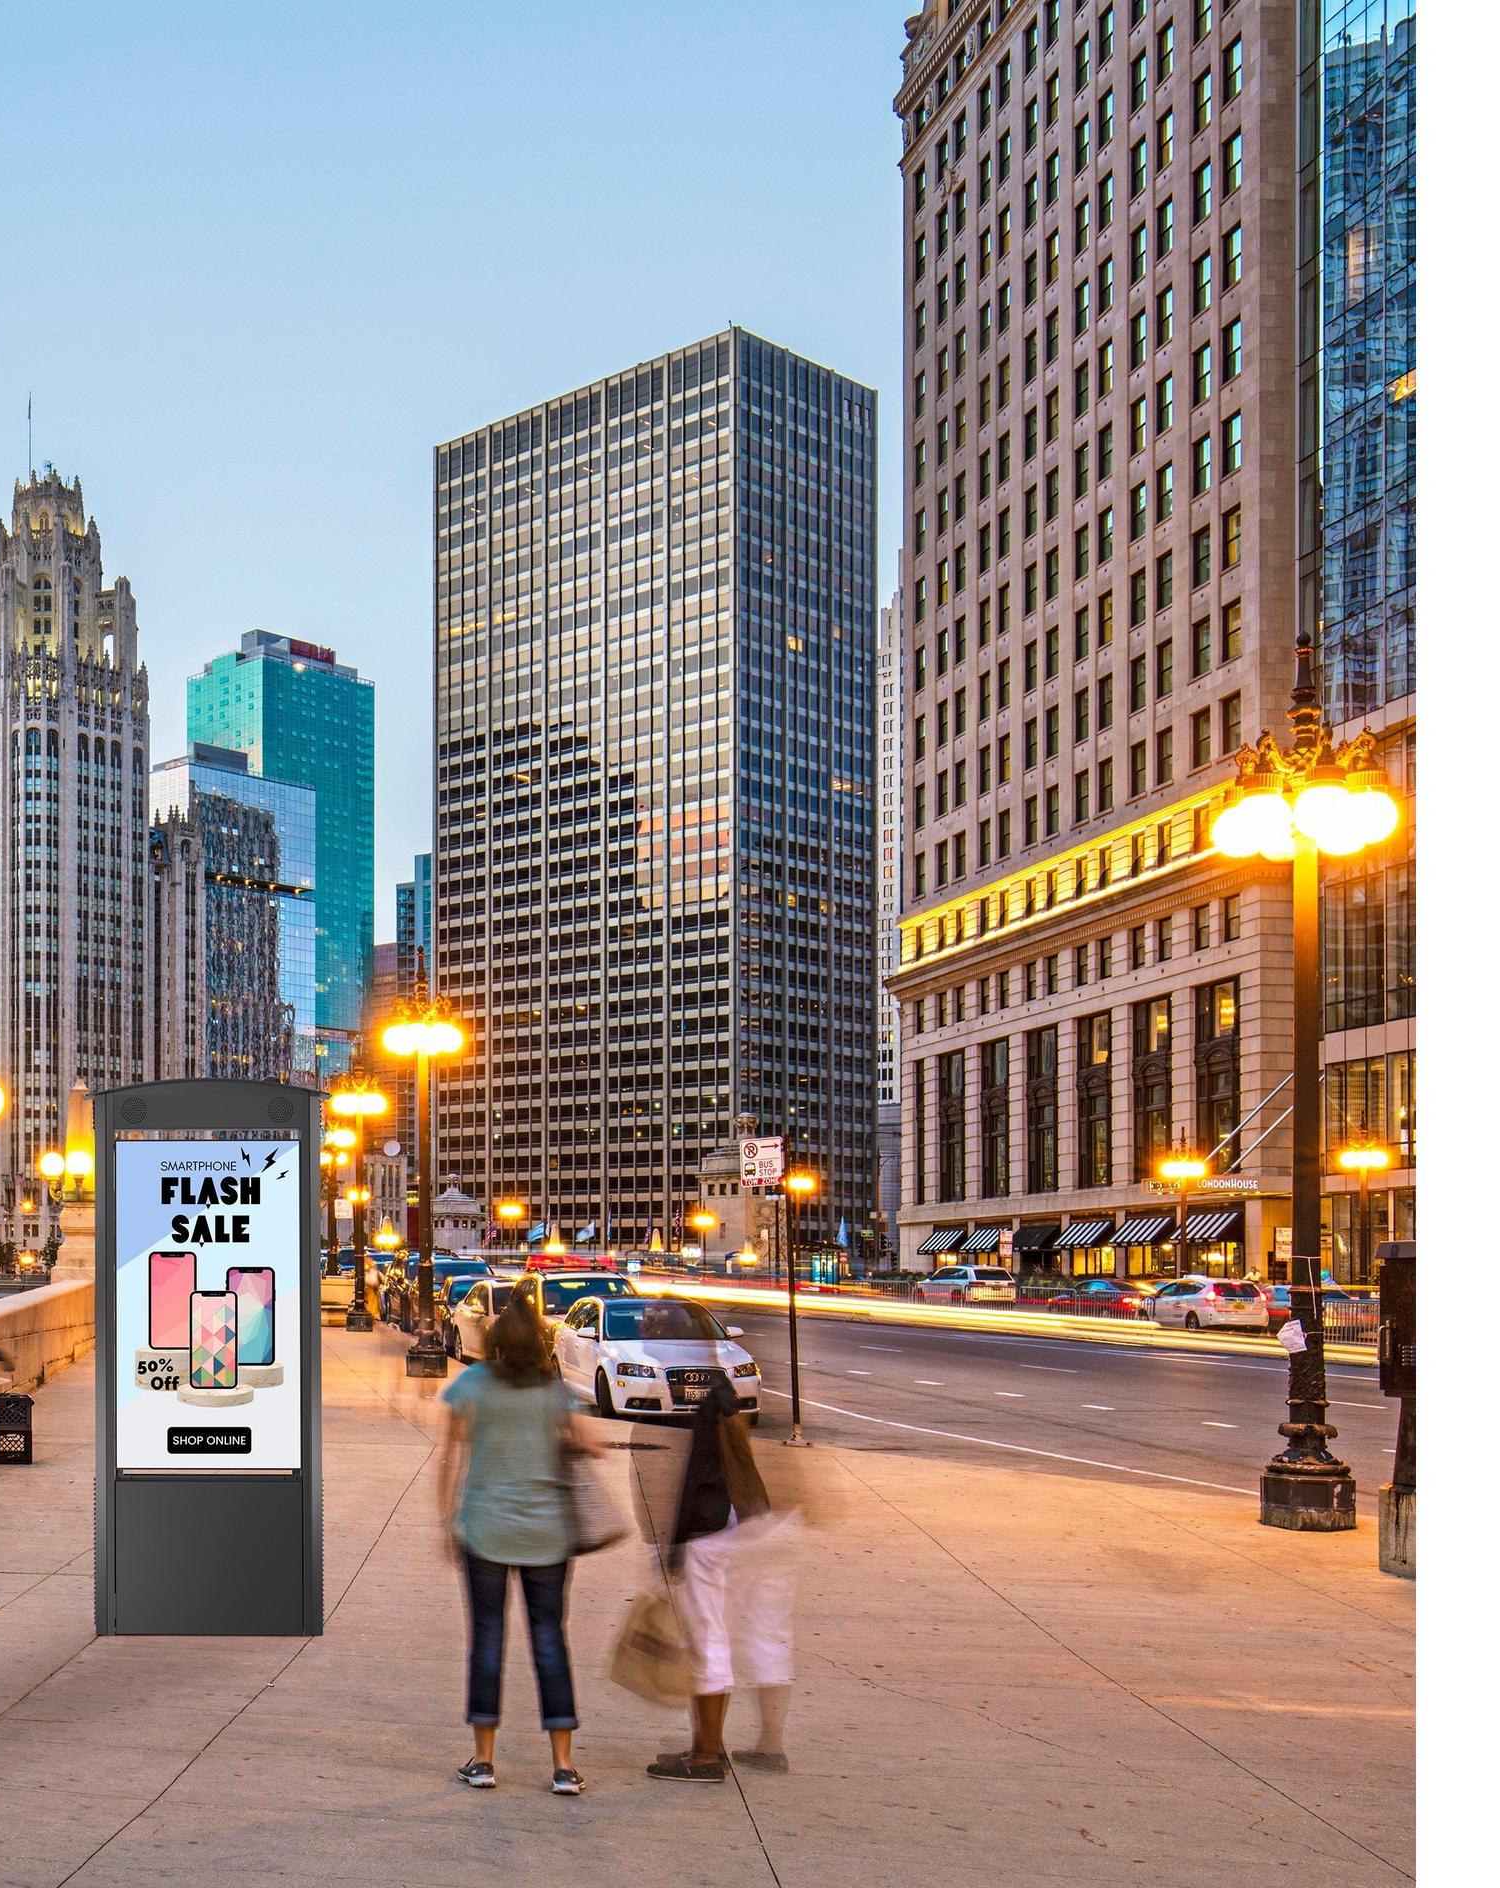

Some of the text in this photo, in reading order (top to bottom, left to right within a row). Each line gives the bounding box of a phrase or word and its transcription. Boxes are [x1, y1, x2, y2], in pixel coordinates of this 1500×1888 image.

[161, 1161, 237, 1172] SMARTPHONE
[759, 1160, 773, 1168] BUS
[759, 1168, 777, 1176] STOP
[1197, 1178, 1259, 1190] LONDONHOUSE
[161, 1176, 261, 1209] FLASH
[171, 1214, 250, 1248] SALE
[137, 1358, 174, 1375] 50%
[150, 1375, 180, 1391] Off
[172, 1435, 247, 1446] SHOP ONLINE
